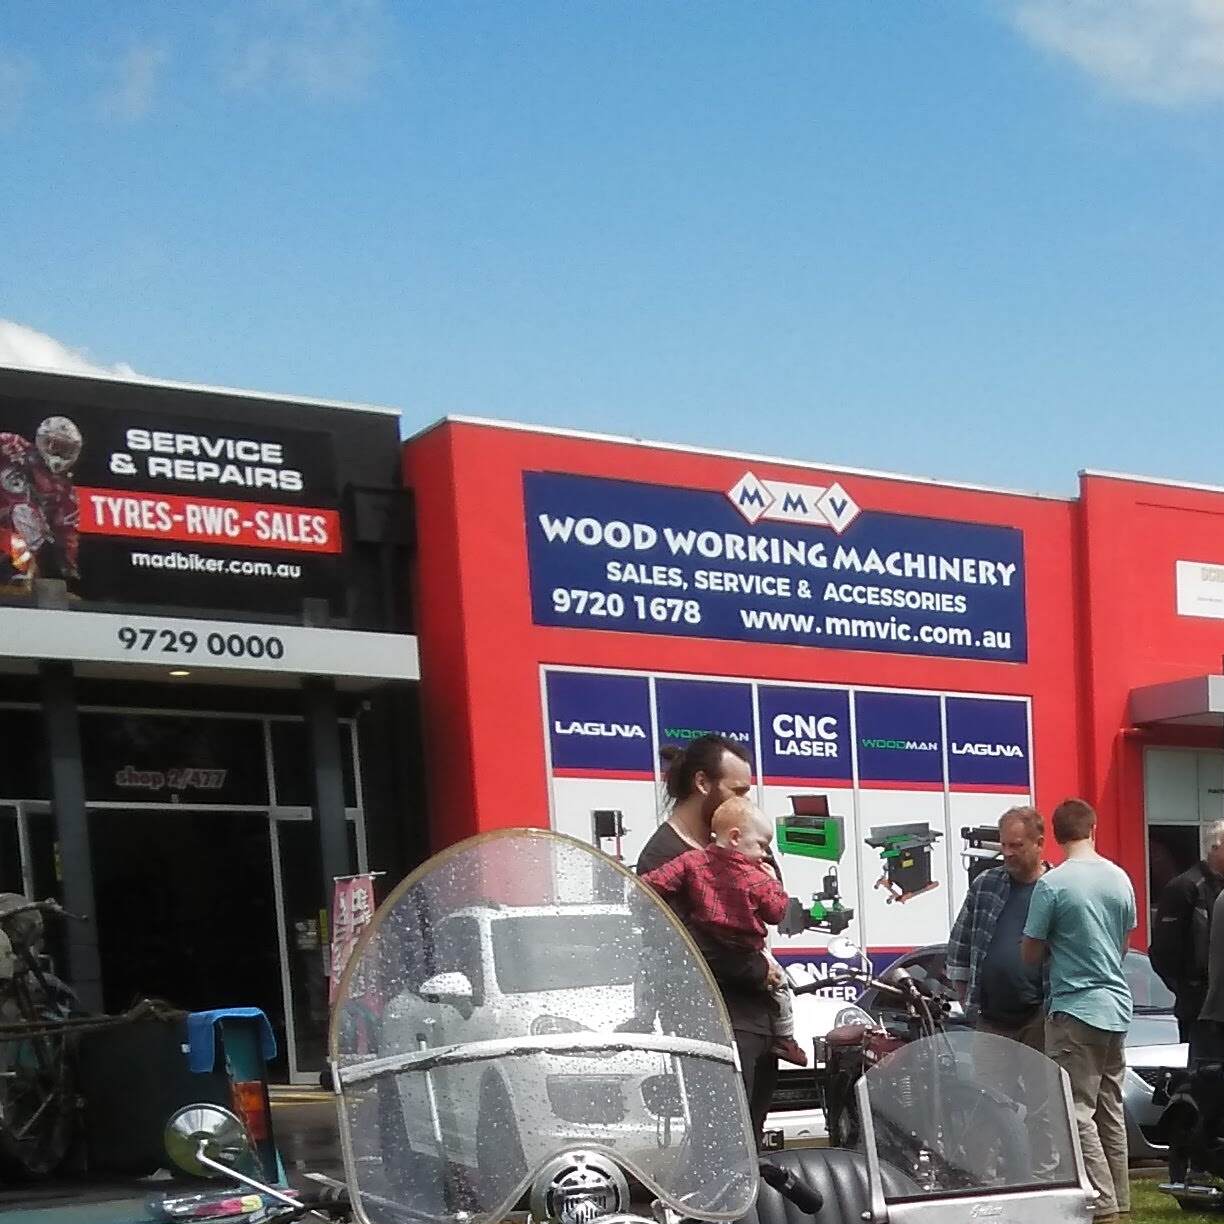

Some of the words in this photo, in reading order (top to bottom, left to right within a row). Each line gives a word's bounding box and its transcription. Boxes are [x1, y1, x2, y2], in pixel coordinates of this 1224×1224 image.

[126, 429, 283, 463] SERVICE
[110, 453, 137, 475] &
[148, 459, 303, 491] REPAIRS
[91, 495, 328, 545] TYRES-RWC-SALES
[130, 551, 301, 578] madbiker.com.au
[539, 514, 657, 550] WOOD
[664, 528, 827, 570] WORKING
[833, 547, 1016, 587] MACHINERY
[606, 561, 688, 590] SALES,
[694, 571, 790, 598] SERVICE
[797, 580, 811, 598] &
[824, 582, 966, 613] ACCESSORIES
[552, 588, 624, 618] 9720
[633, 596, 701, 624] 1678
[740, 608, 1011, 649] www.mmvic.com.au
[118, 627, 198, 654] 9729
[206, 631, 284, 659] 0000
[555, 720, 646, 739] LAGUNA
[773, 713, 838, 740] CNC
[775, 739, 838, 758] LASER
[861, 738, 938, 752] WOODMAN
[951, 742, 1024, 758] LAGUNA
